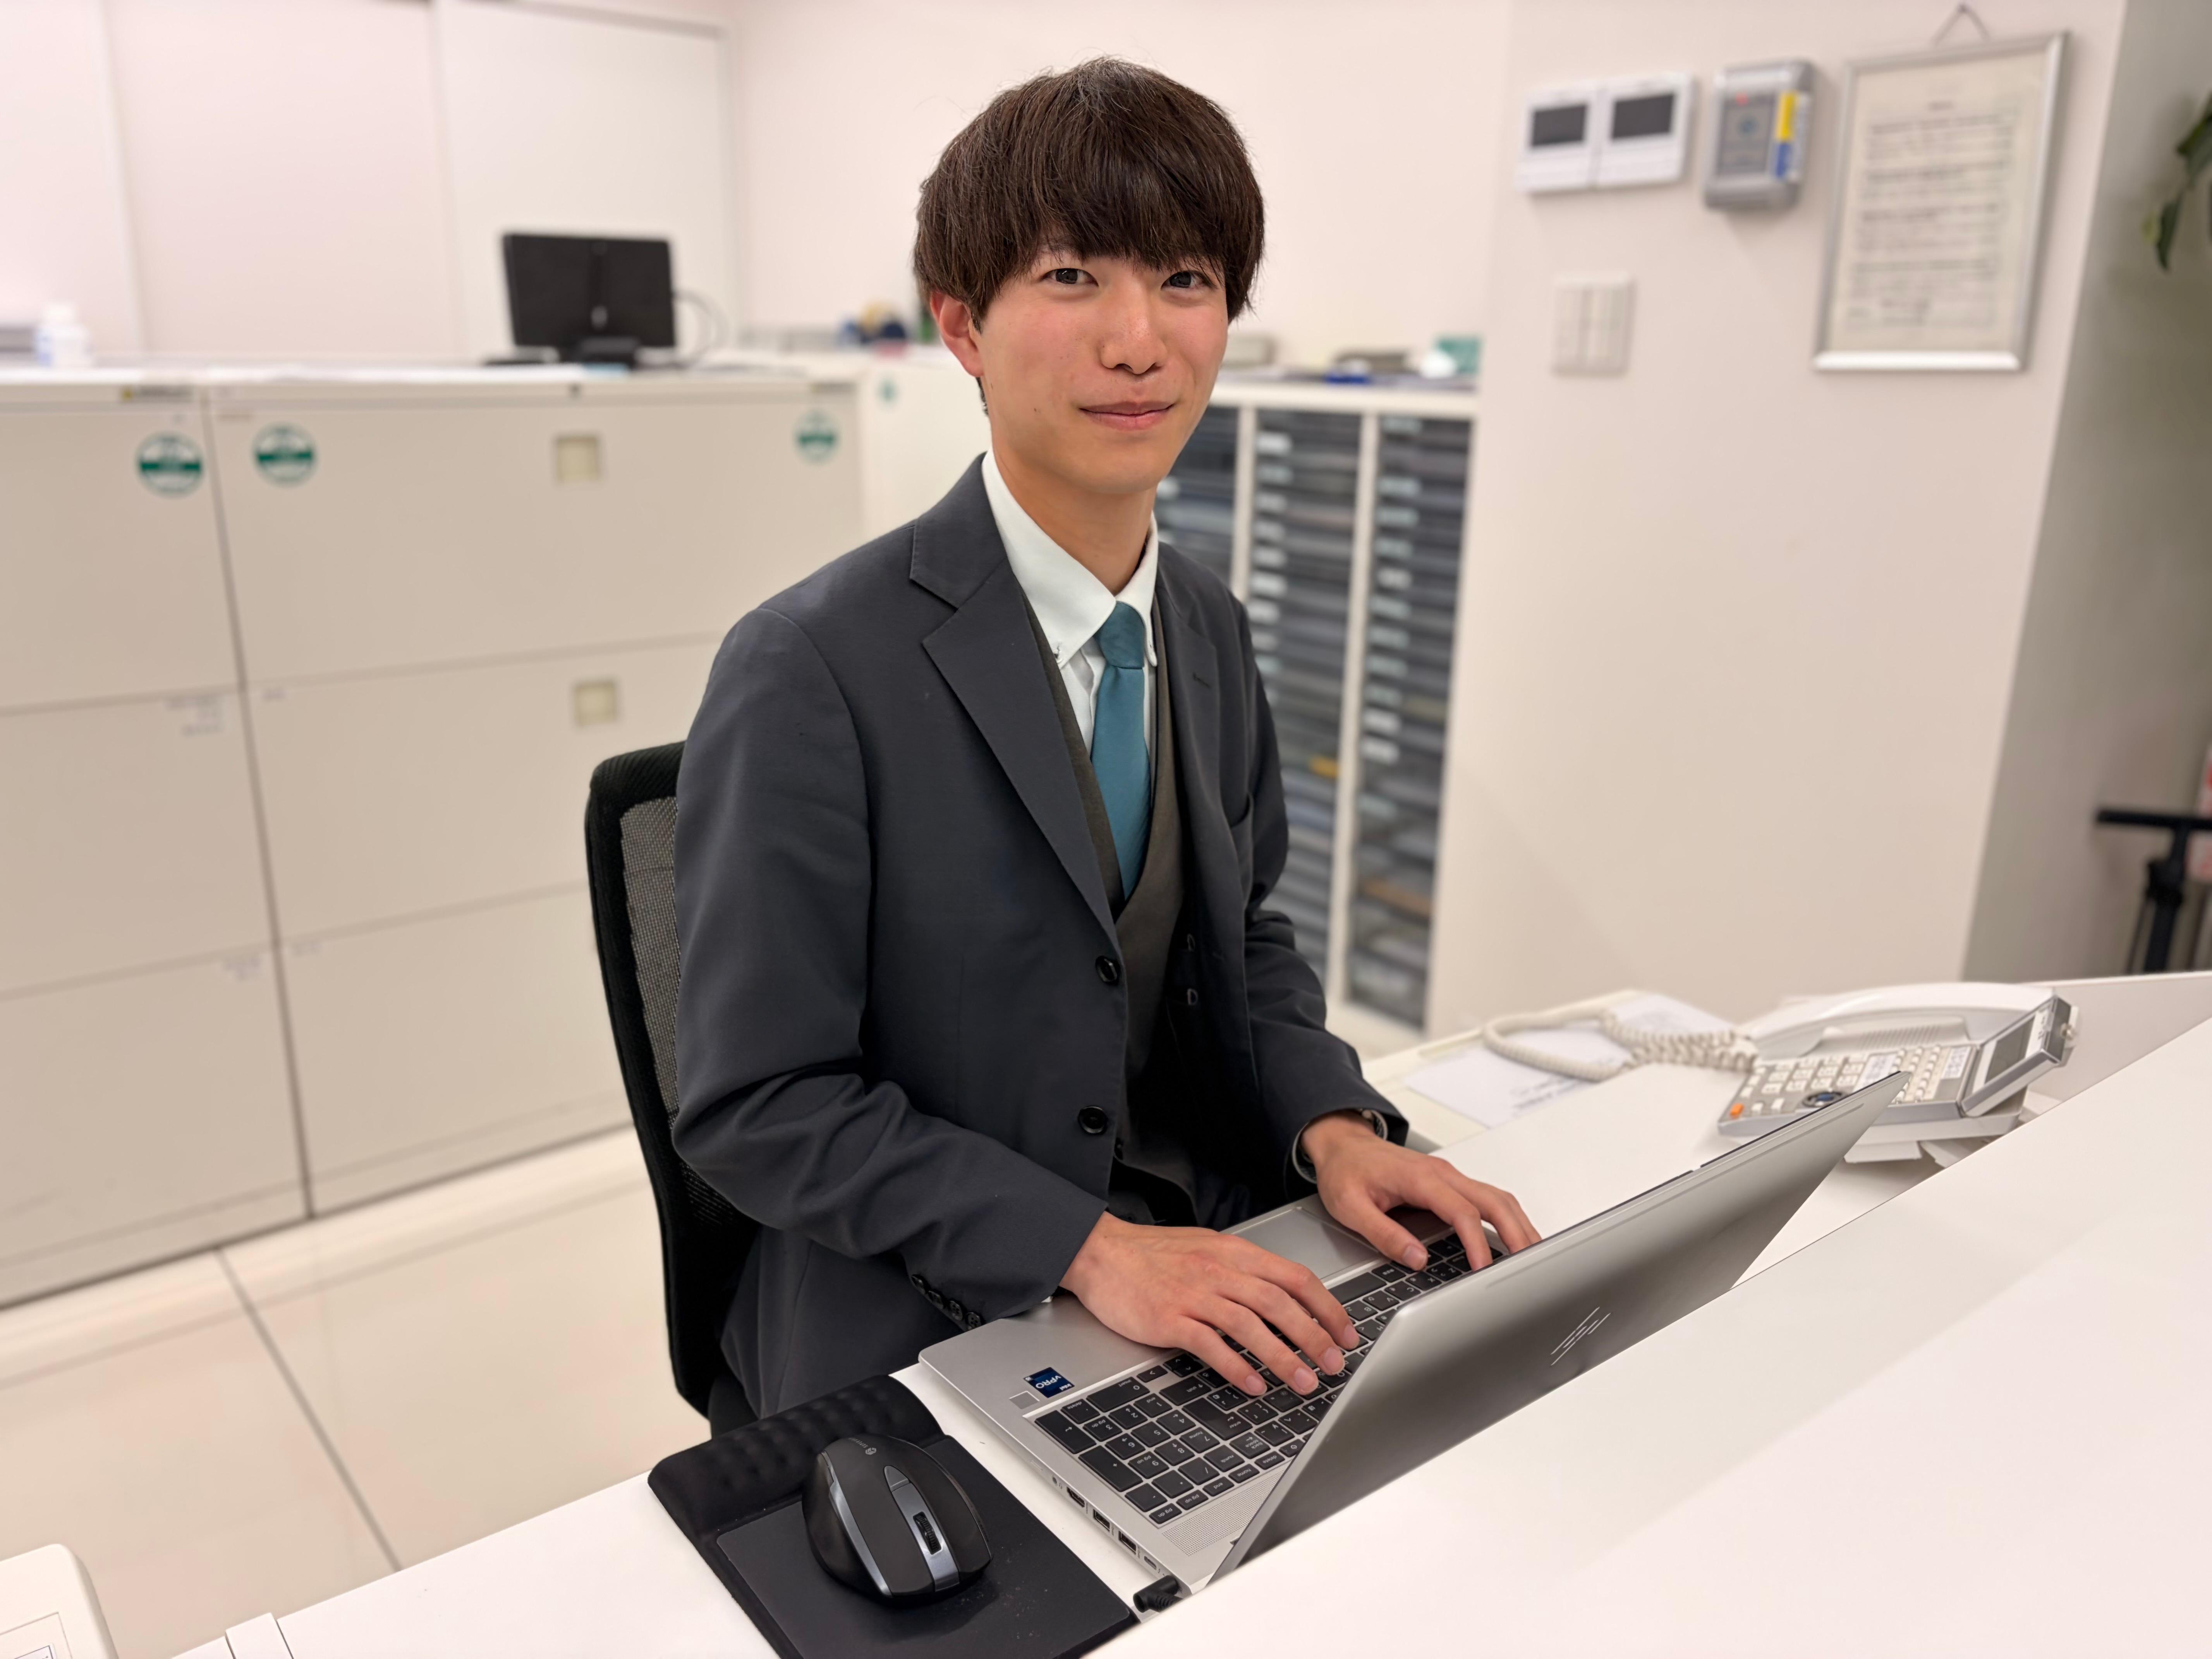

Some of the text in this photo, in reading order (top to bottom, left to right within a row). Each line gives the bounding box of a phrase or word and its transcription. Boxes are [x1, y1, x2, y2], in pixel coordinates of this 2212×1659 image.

[1036, 1376, 1062, 1389] vPRO
[1067, 1401, 1082, 1409] delete
[1245, 1440, 1259, 1448] space
[1262, 1455, 1276, 1463] delete
[1237, 1468, 1251, 1476] home
